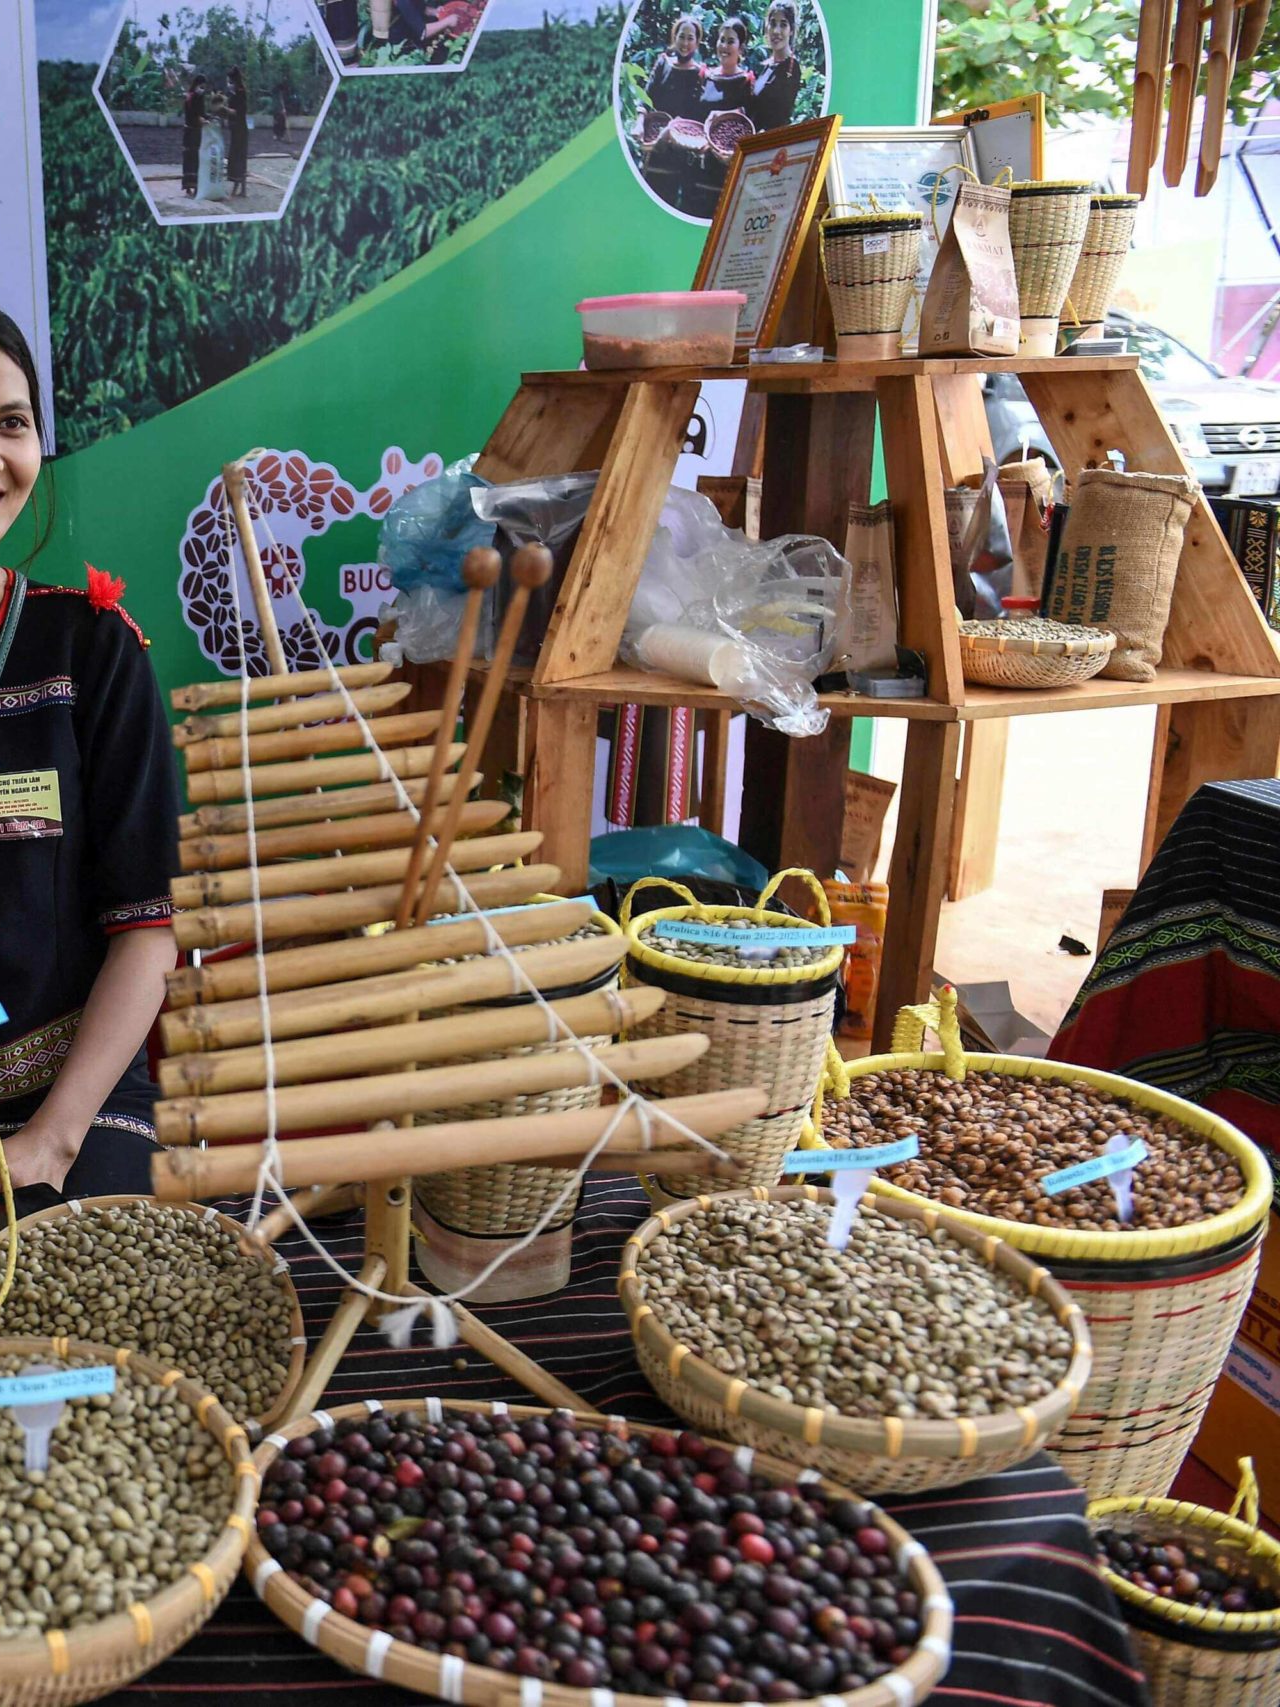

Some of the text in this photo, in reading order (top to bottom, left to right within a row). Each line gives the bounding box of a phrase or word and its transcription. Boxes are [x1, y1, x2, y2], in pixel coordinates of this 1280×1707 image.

[744, 213, 776, 233] OCOP
[661, 923, 701, 936] Arabica
[723, 929, 752, 941] Clean
